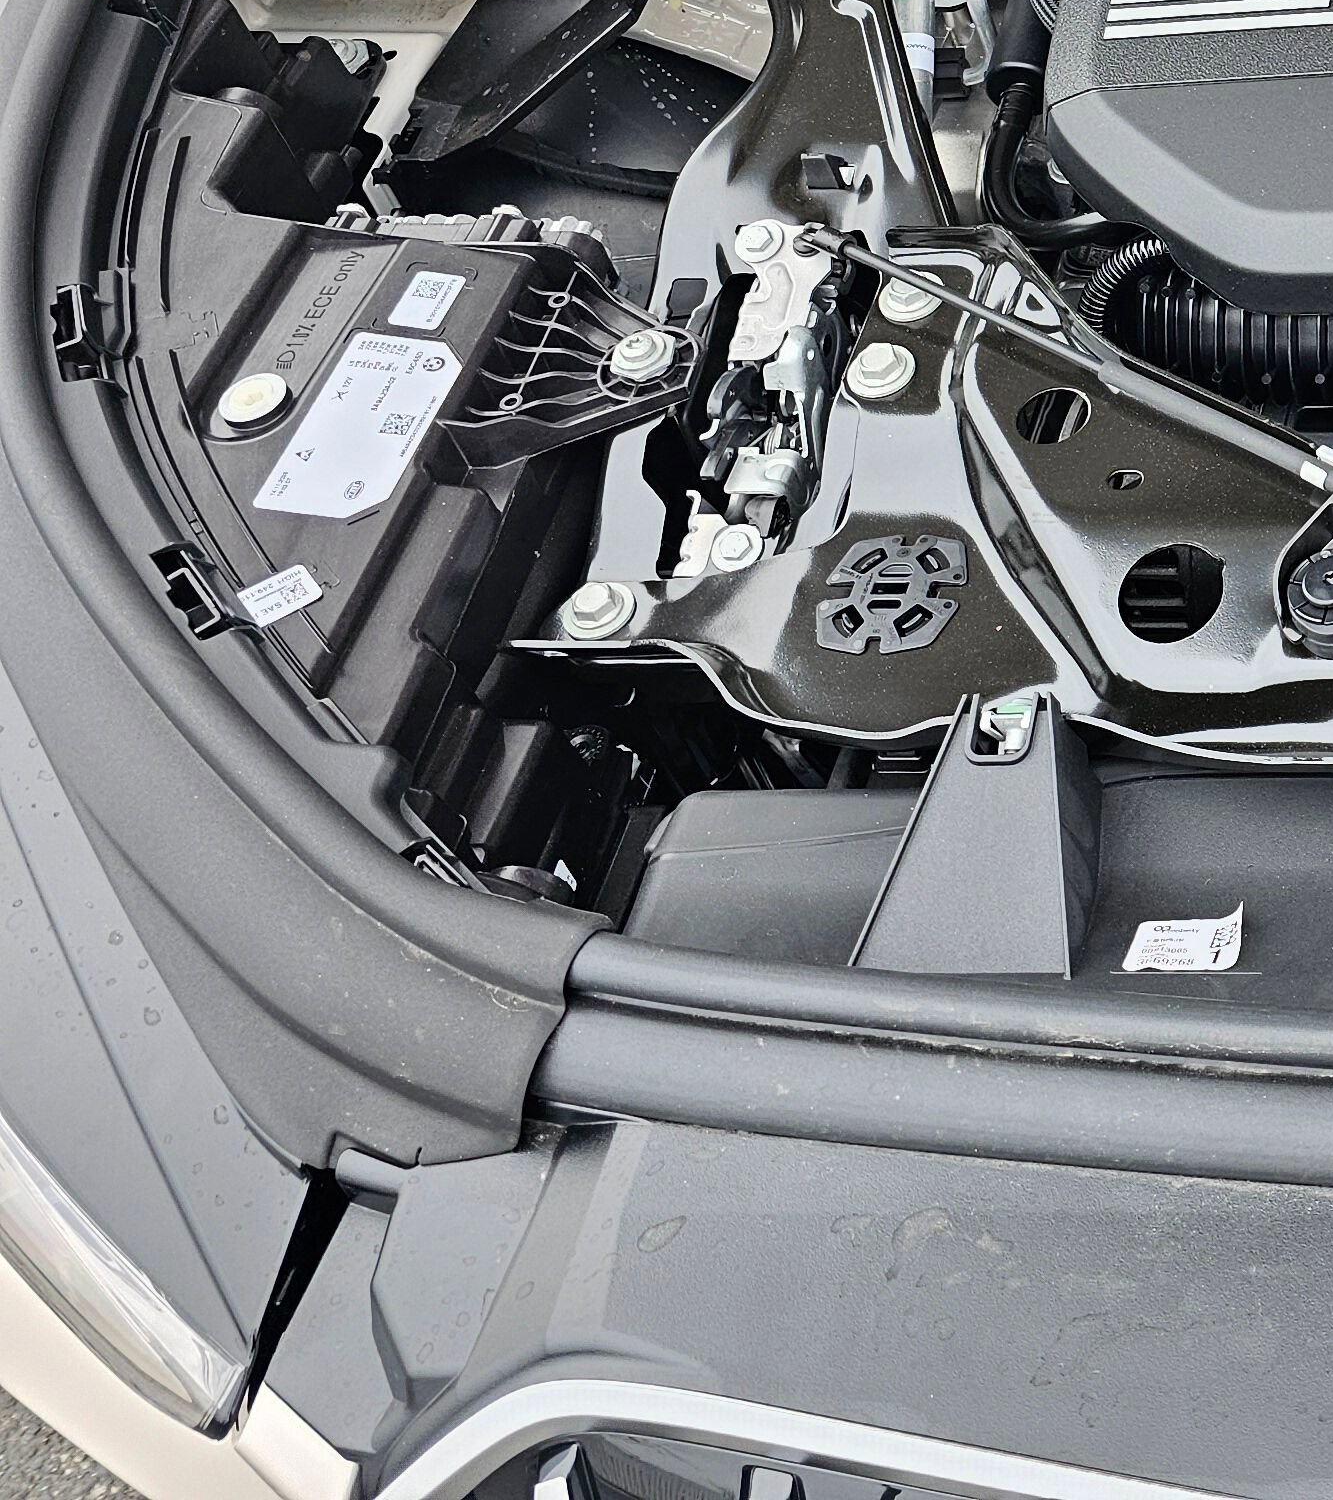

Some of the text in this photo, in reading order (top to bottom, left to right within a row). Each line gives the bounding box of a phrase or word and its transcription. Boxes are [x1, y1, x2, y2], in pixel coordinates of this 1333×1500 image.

[304, 285, 341, 317] ECE
[333, 249, 365, 280] only
[340, 376, 354, 388] 12V
[260, 600, 282, 616] SAE
[1210, 949, 1221, 964] 1
